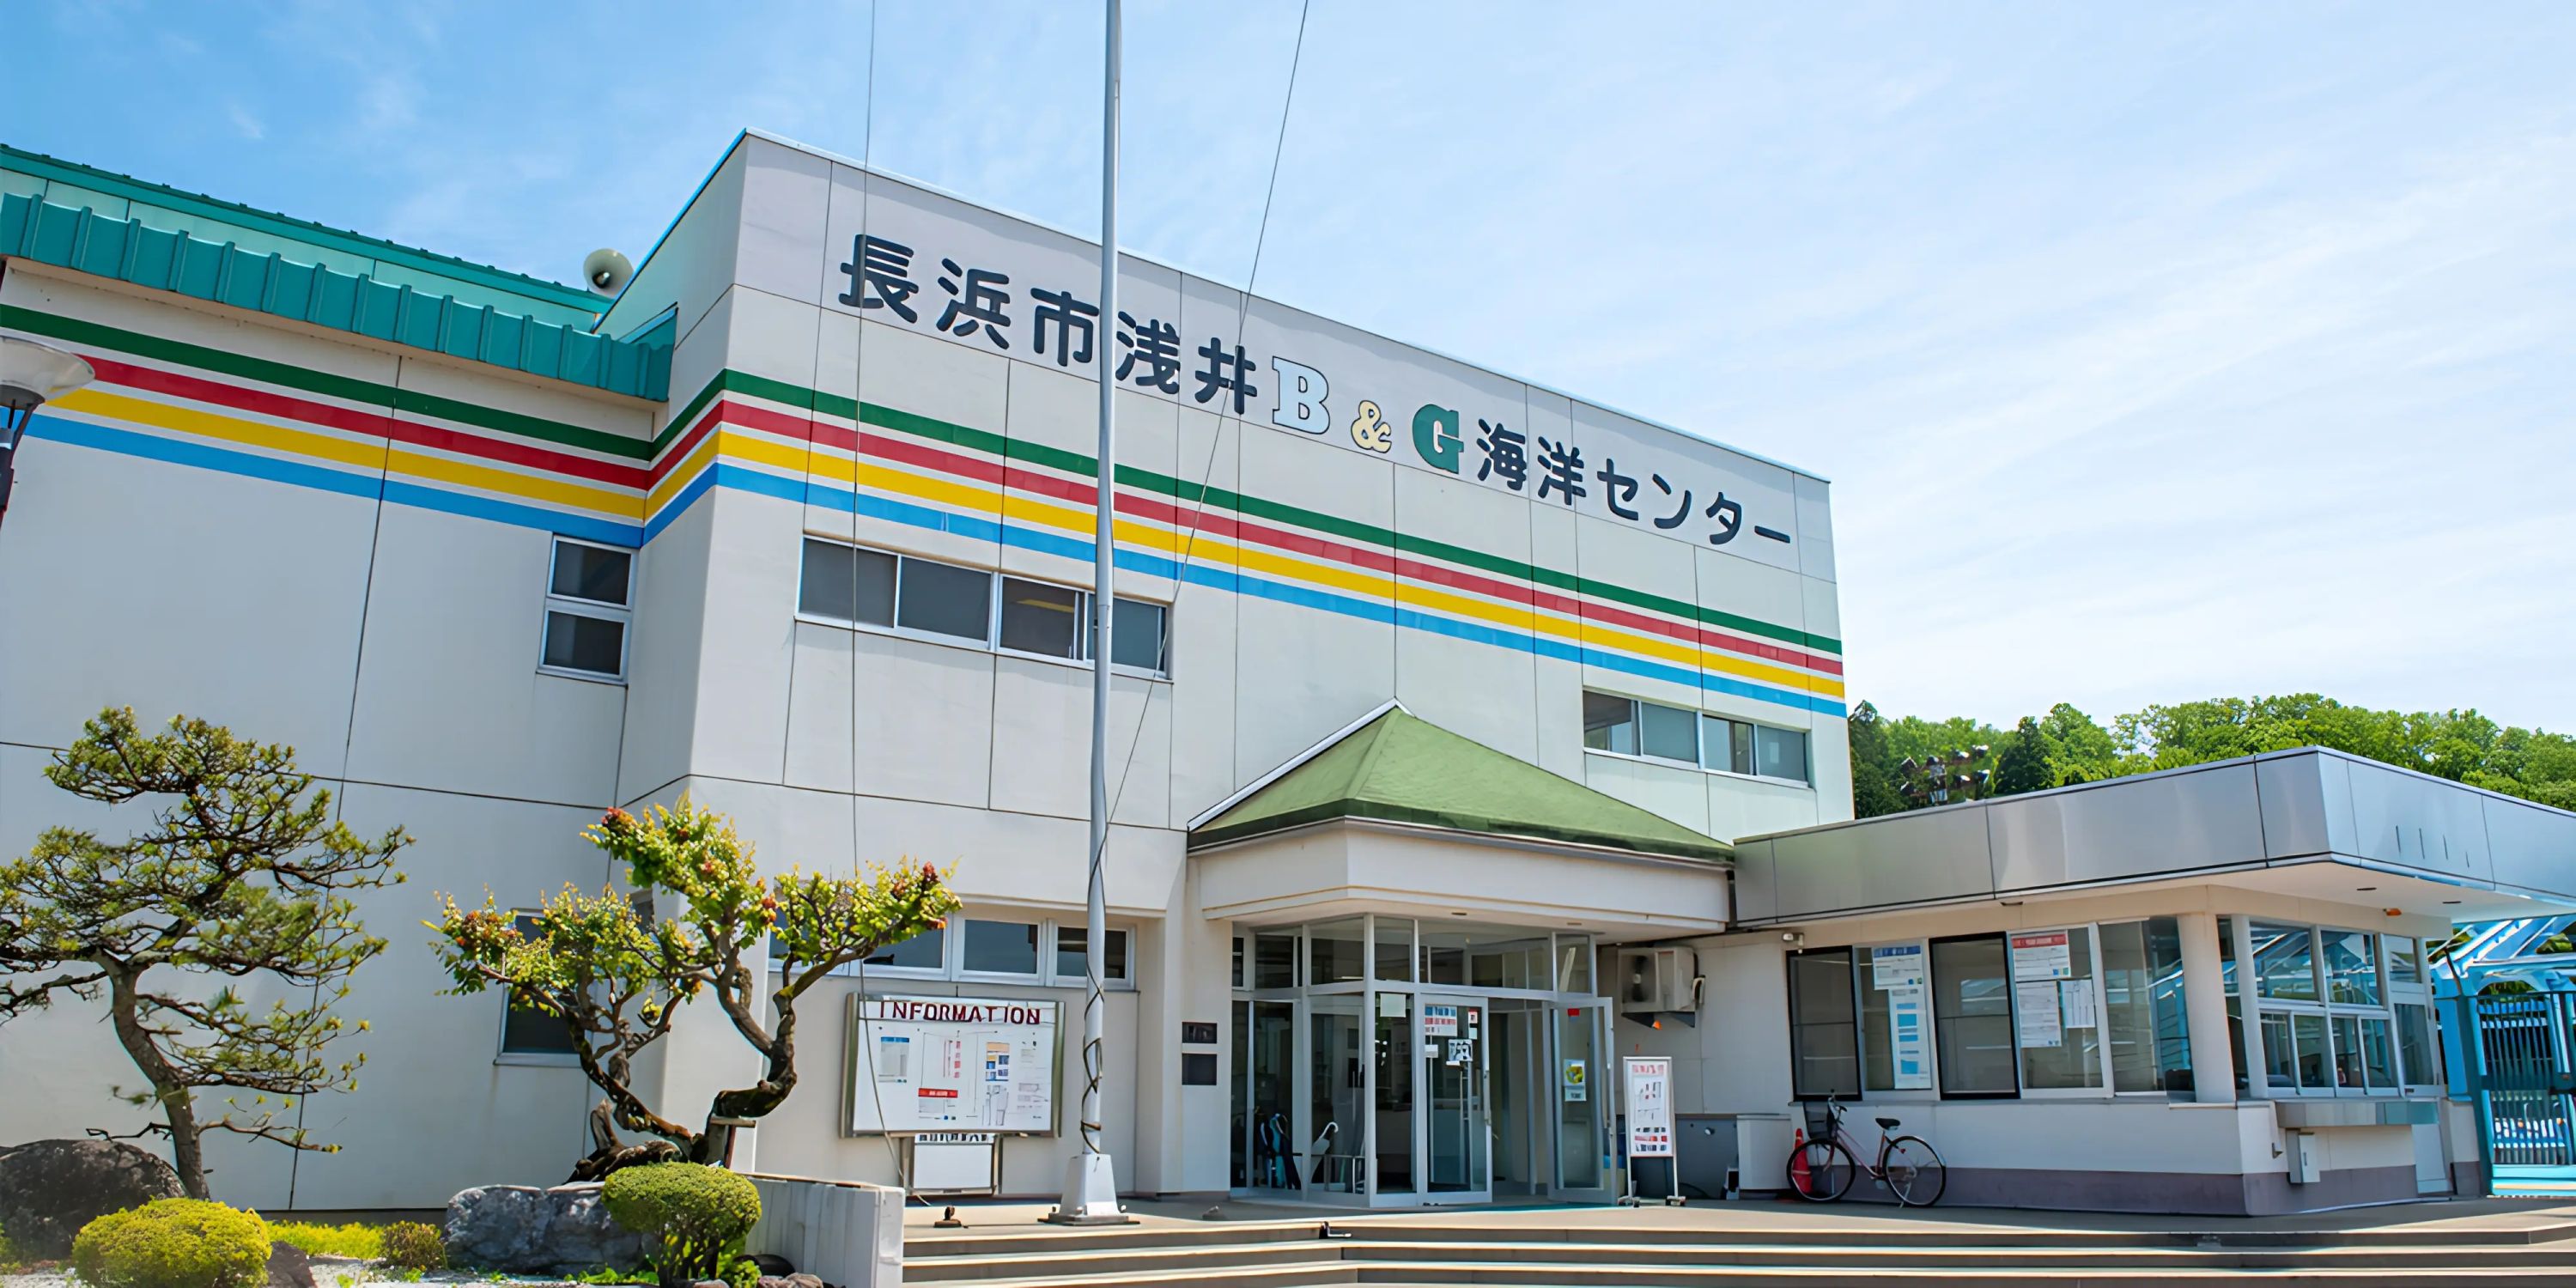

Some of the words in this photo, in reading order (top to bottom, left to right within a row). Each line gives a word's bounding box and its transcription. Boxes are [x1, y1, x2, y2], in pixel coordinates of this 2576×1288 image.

[838, 234, 1258, 415] 長浜市浅井
[1476, 418, 1791, 545] 海洋センター
[880, 999, 1041, 1025] INFORMATION
